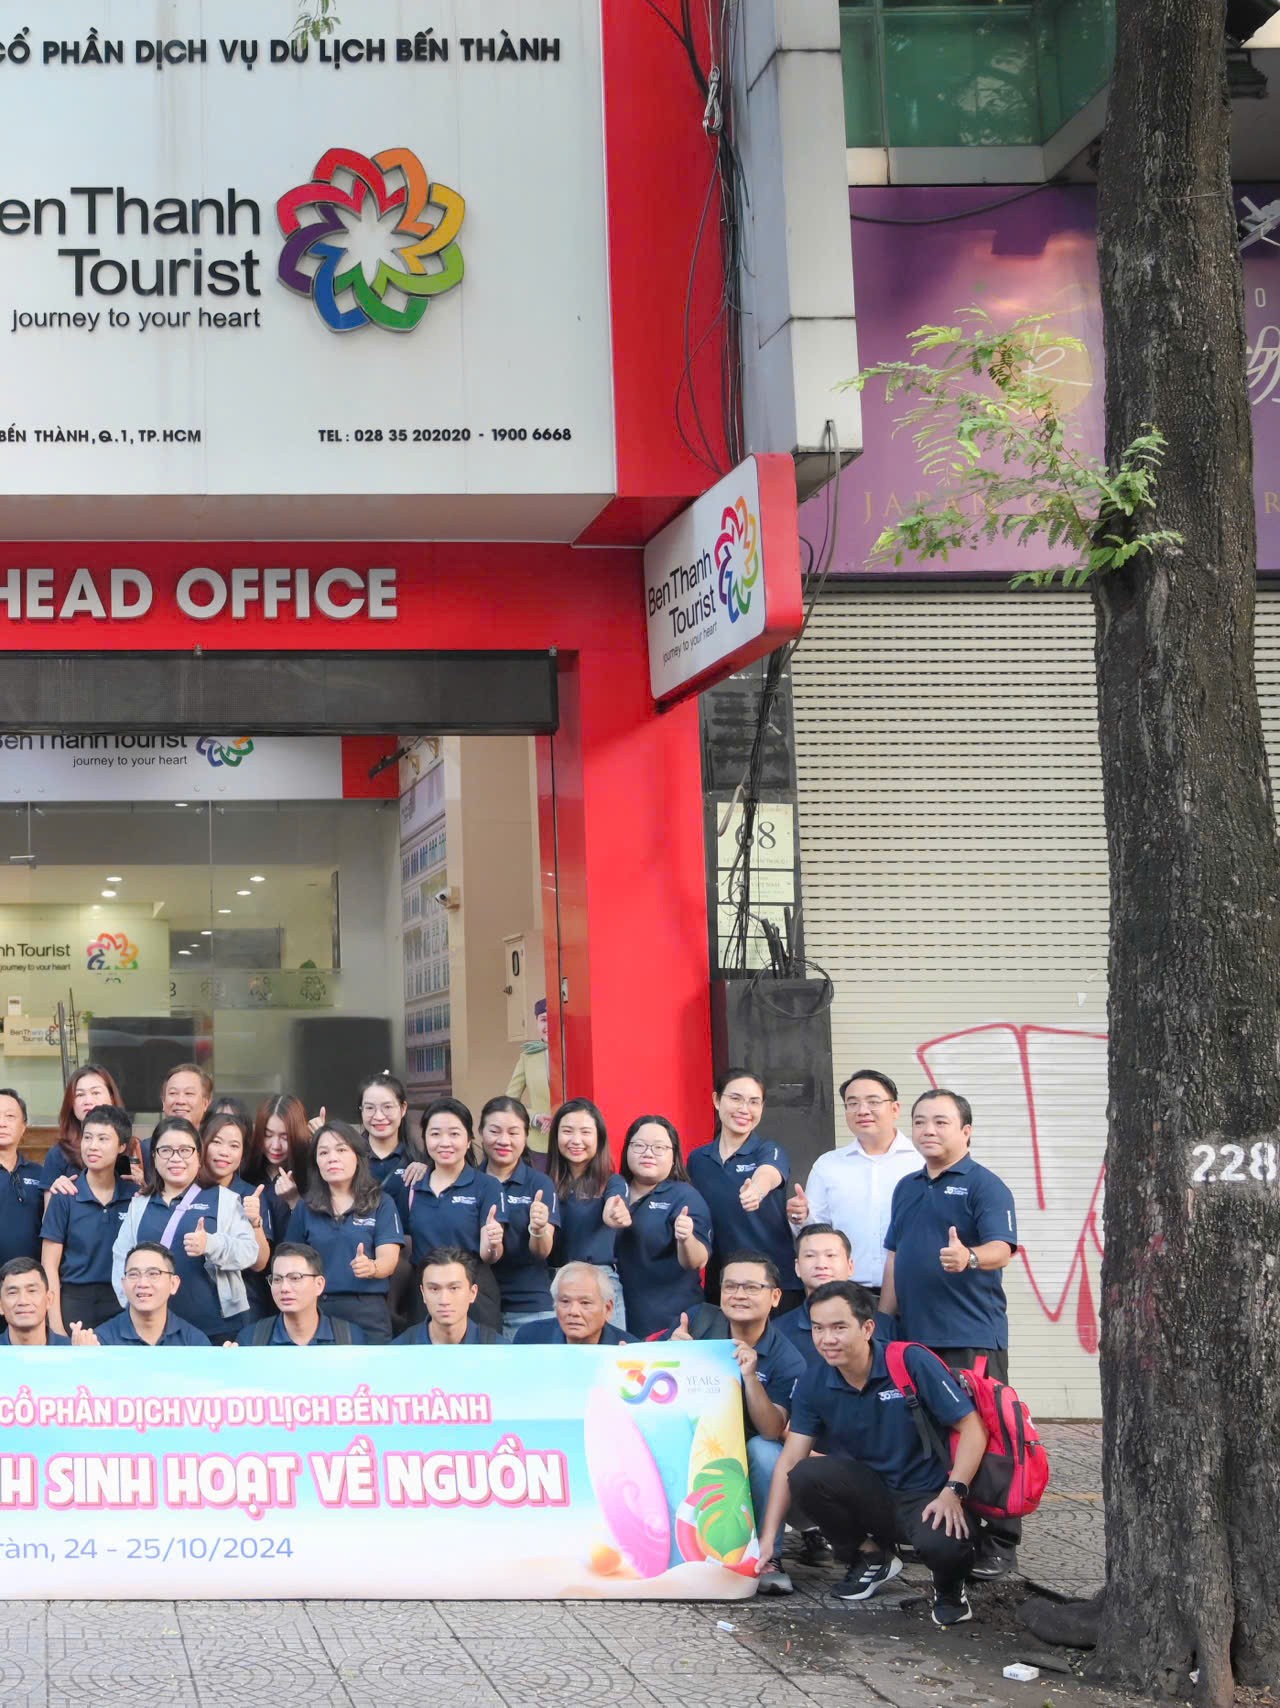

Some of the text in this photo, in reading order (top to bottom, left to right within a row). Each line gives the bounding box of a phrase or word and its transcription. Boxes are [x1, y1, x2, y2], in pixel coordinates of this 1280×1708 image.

[43, 27, 123, 65] PHẦN
[135, 39, 206, 70] DỊCH
[219, 39, 258, 70] VỤ
[270, 38, 309, 63] DU
[319, 38, 386, 70] LỊCH
[396, 27, 449, 62] BẾN
[460, 29, 561, 62] THÀNH
[58, 248, 262, 297] Tourist
[11, 307, 261, 332] journey to your heart
[354, 429, 384, 442] 028
[388, 429, 408, 442] 35
[412, 428, 471, 442] 202020
[491, 428, 528, 441] 1900
[532, 427, 572, 441] 6668
[176, 567, 399, 620] OFFICE
[668, 584, 717, 638] Tourist
[72, 755, 188, 769] journey to your heart
[1191, 1141, 1277, 1182] 228
[38, 1386, 115, 1425] PHẦN
[120, 1397, 184, 1431] DỊCH
[184, 1398, 222, 1431] VỤ
[226, 1398, 266, 1424] DU
[268, 1397, 331, 1431] LỊCH
[334, 1386, 391, 1423] BẾN
[392, 1388, 491, 1423] THÀNH
[46, 1455, 154, 1507] SINH
[166, 1454, 299, 1518] HOẠT
[310, 1438, 378, 1505] VỀ
[387, 1435, 567, 1505] NGUỒN
[63, 1537, 99, 1560] 24
[126, 1536, 294, 1562] 25/10/2024
